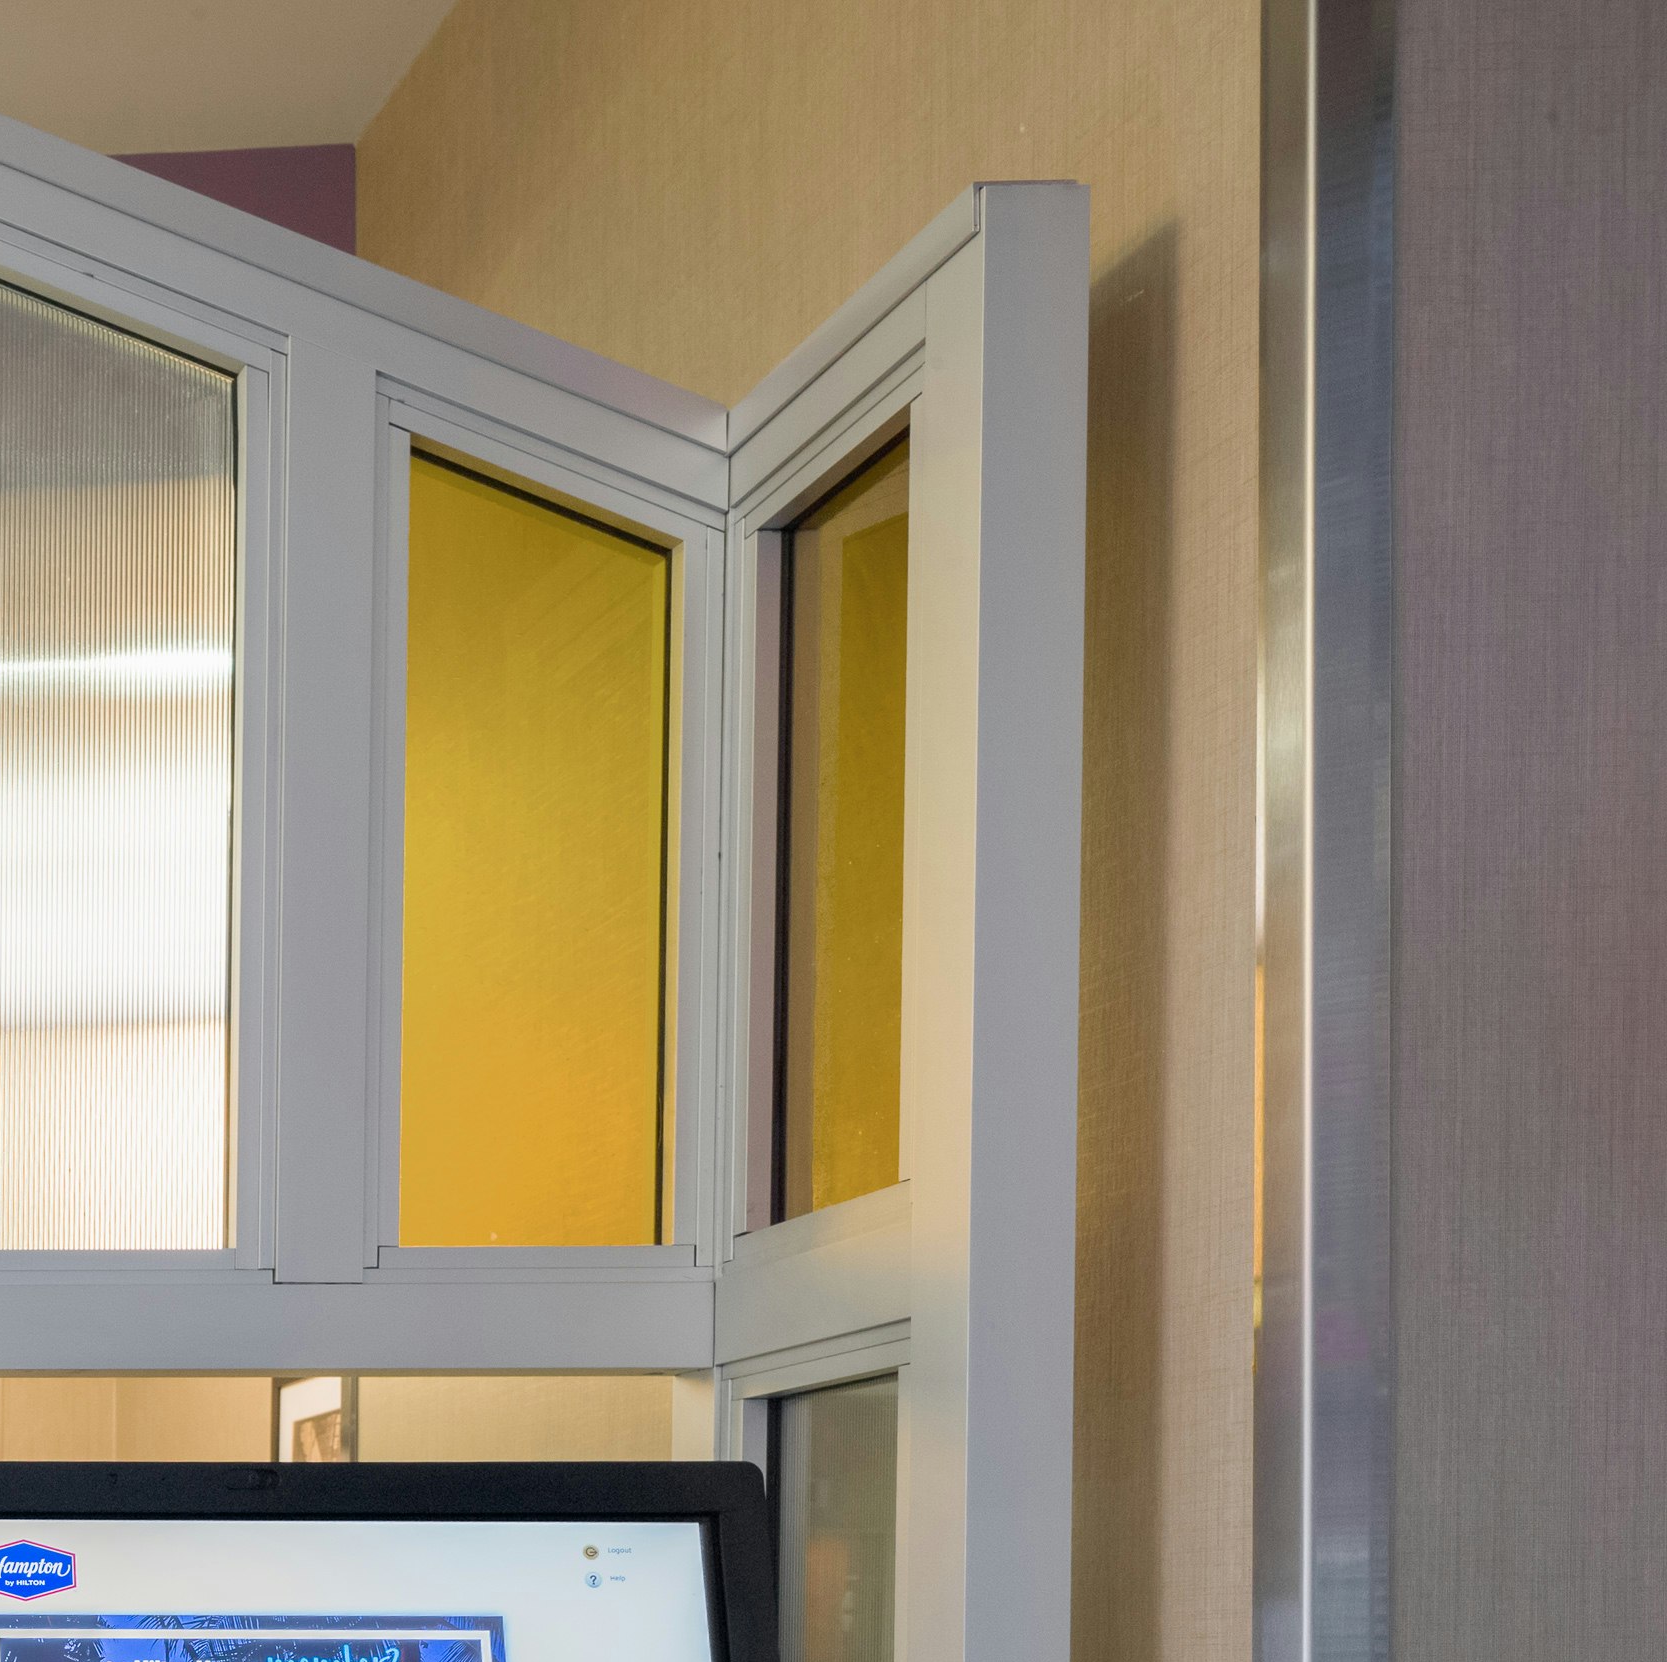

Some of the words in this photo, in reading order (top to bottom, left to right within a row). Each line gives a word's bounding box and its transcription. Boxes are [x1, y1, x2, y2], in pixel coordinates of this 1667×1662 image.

[607, 1546, 632, 1555] Logout
[4, 1579, 14, 1587] by
[16, 1579, 46, 1587] HILTON
